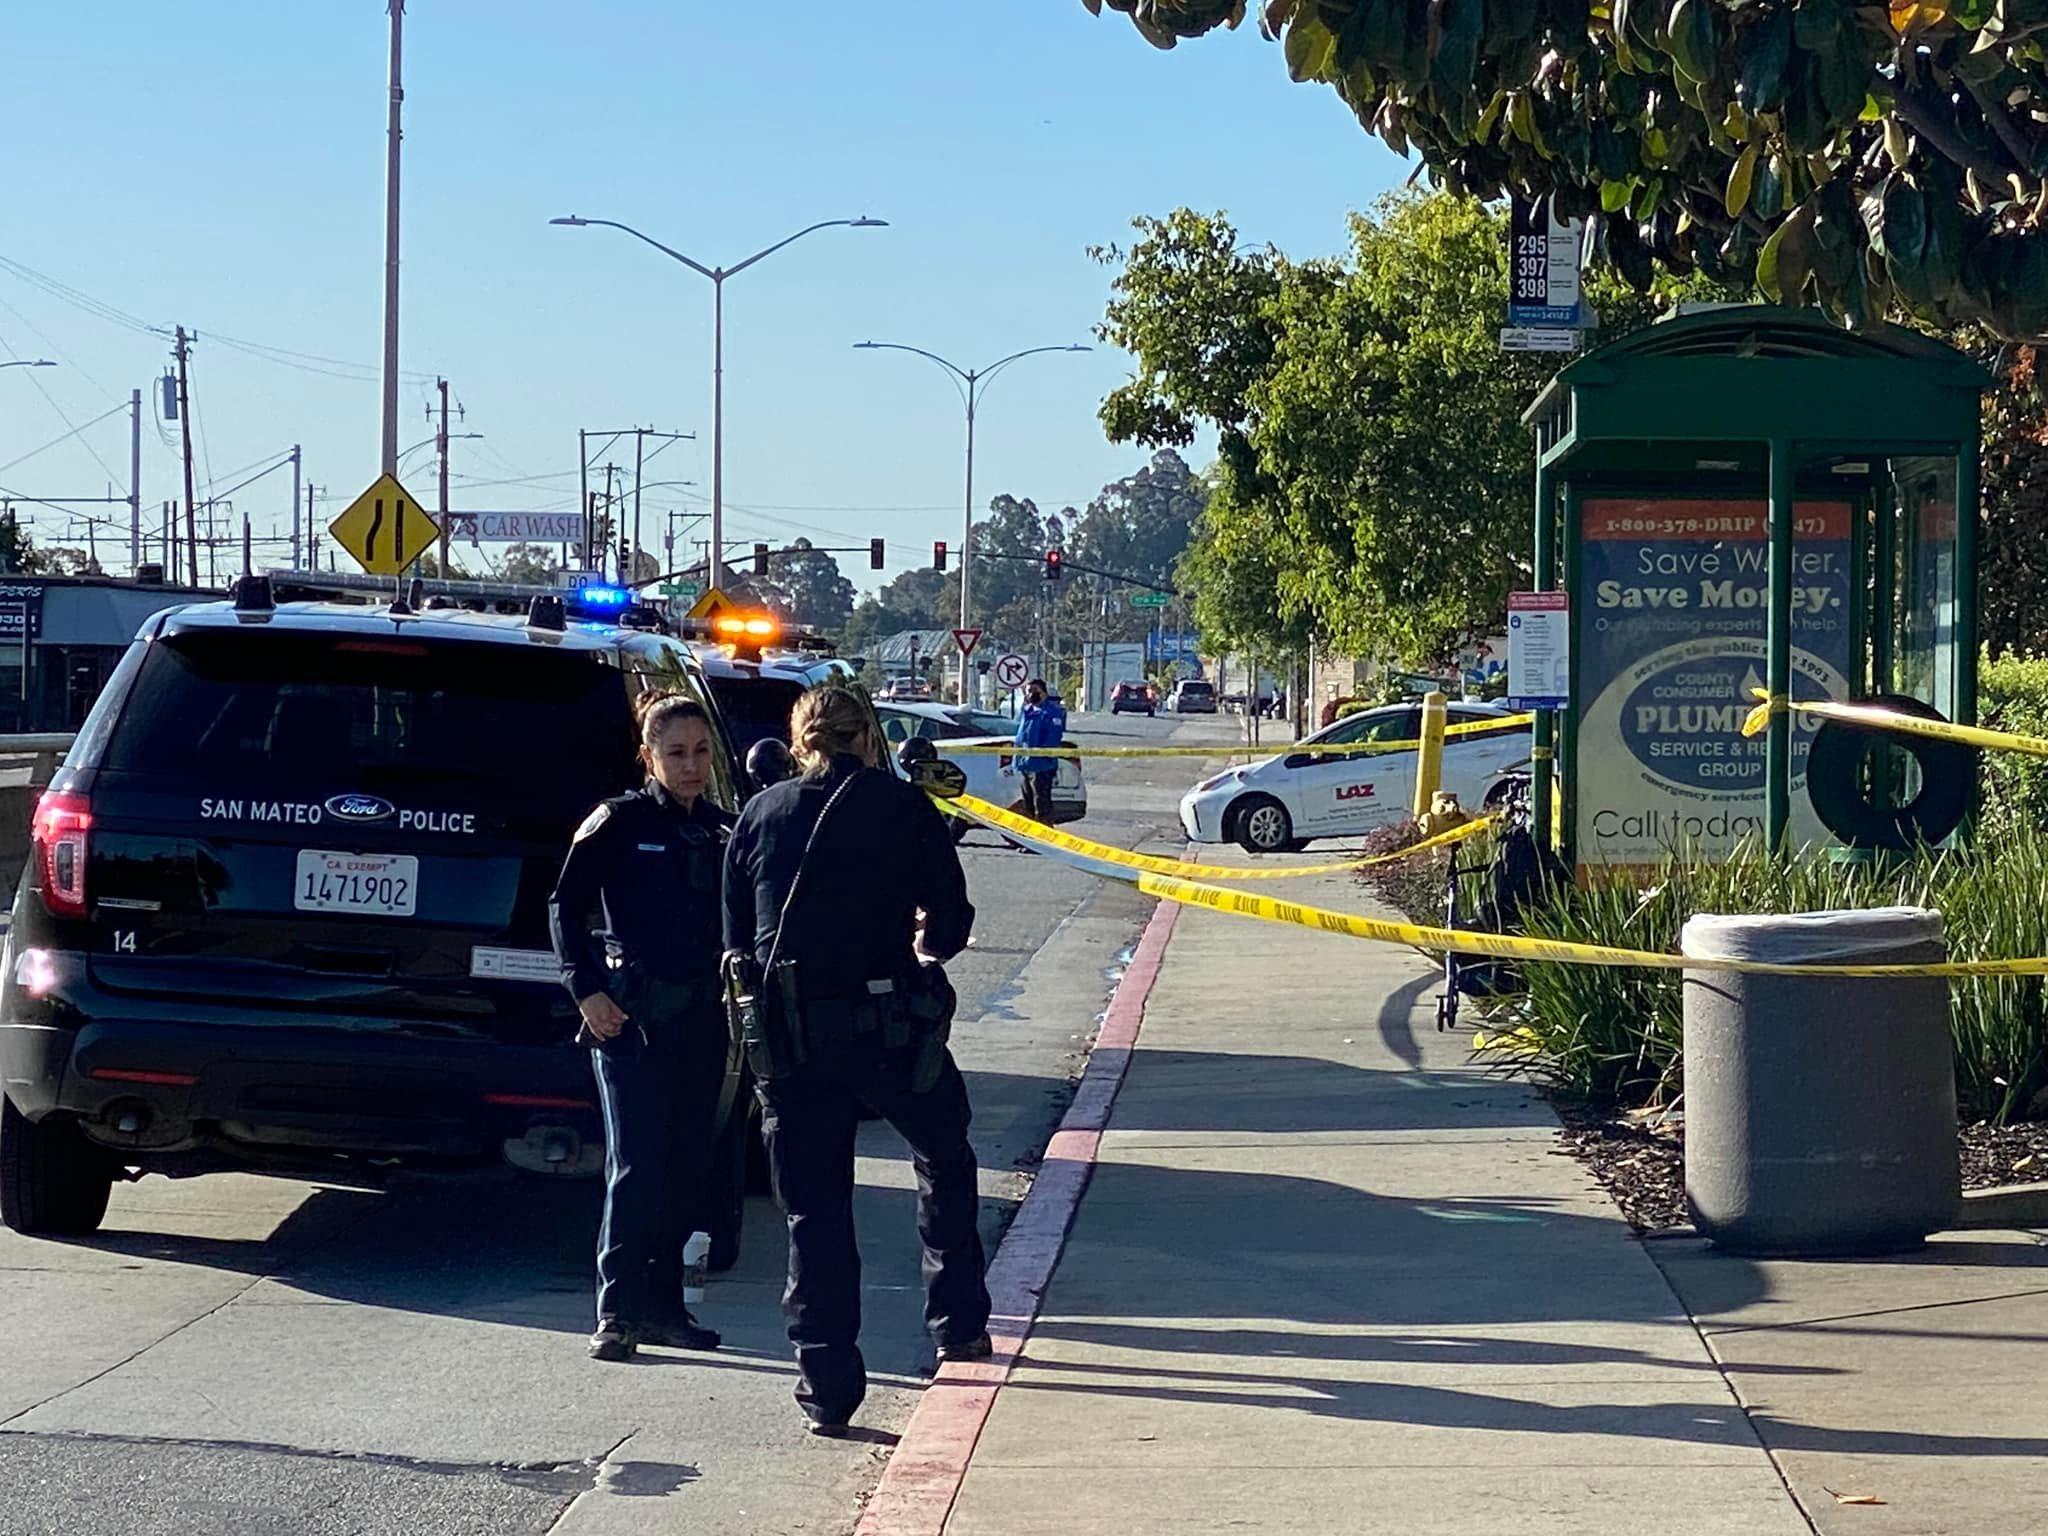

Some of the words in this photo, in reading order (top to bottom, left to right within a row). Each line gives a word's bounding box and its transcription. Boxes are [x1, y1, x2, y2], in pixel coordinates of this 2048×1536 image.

[1518, 236, 1546, 254] 295
[1518, 258, 1546, 276] 397
[1518, 279, 1546, 297] 398
[482, 515, 520, 537] CAR
[525, 516, 580, 537] WASH
[1606, 517, 1755, 533] 1-800-378-DRIP
[1762, 517, 1825, 534] (47)
[1638, 547, 1720, 574] Save
[1734, 547, 1840, 574] Wter.
[1597, 580, 1688, 608] Save
[1704, 619, 1762, 632] experts
[1713, 641, 1762, 654] public
[1800, 657, 1829, 682] 1903
[1675, 673, 1735, 686] COUNTY
[1652, 686, 1735, 698] CONSUMER
[1649, 742, 1724, 756] SERVICE
[1730, 742, 1742, 756] &
[1698, 763, 1761, 776] GROUP
[1335, 783, 1376, 800] LAZ
[1640, 771, 1710, 802] emergency
[340, 798, 379, 815] Ford
[200, 799, 243, 819] SAN
[250, 801, 322, 825] MATEO
[399, 810, 475, 834] POLICE
[1593, 810, 1658, 838] Call
[326, 861, 341, 869] CA
[347, 862, 387, 872] EXEMPT
[304, 873, 408, 906] 1471902
[114, 930, 136, 953] 14
